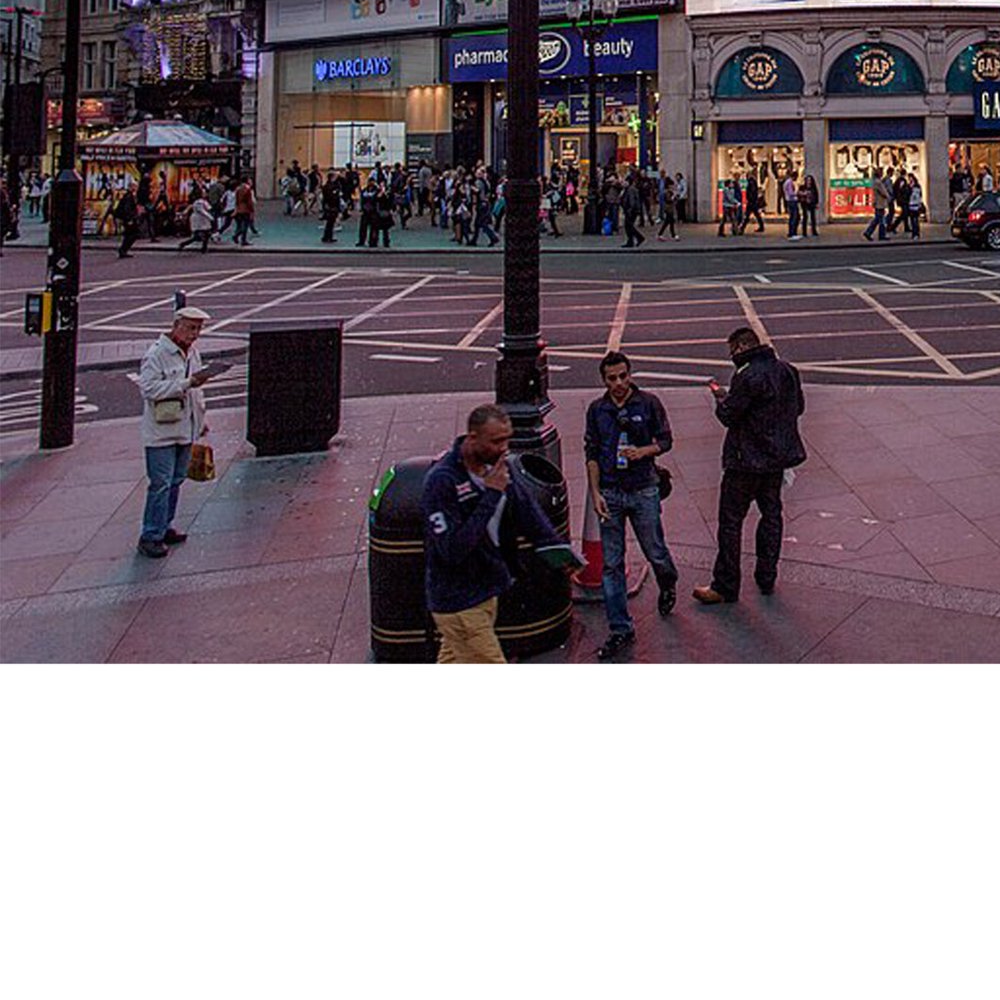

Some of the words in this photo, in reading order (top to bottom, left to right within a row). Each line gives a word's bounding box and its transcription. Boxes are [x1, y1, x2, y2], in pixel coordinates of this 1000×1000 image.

[328, 56, 391, 79] BARCLAYS
[454, 48, 508, 69] pharmac
[747, 61, 772, 77] GAP
[862, 58, 889, 75] GAP
[428, 511, 449, 535] 3
